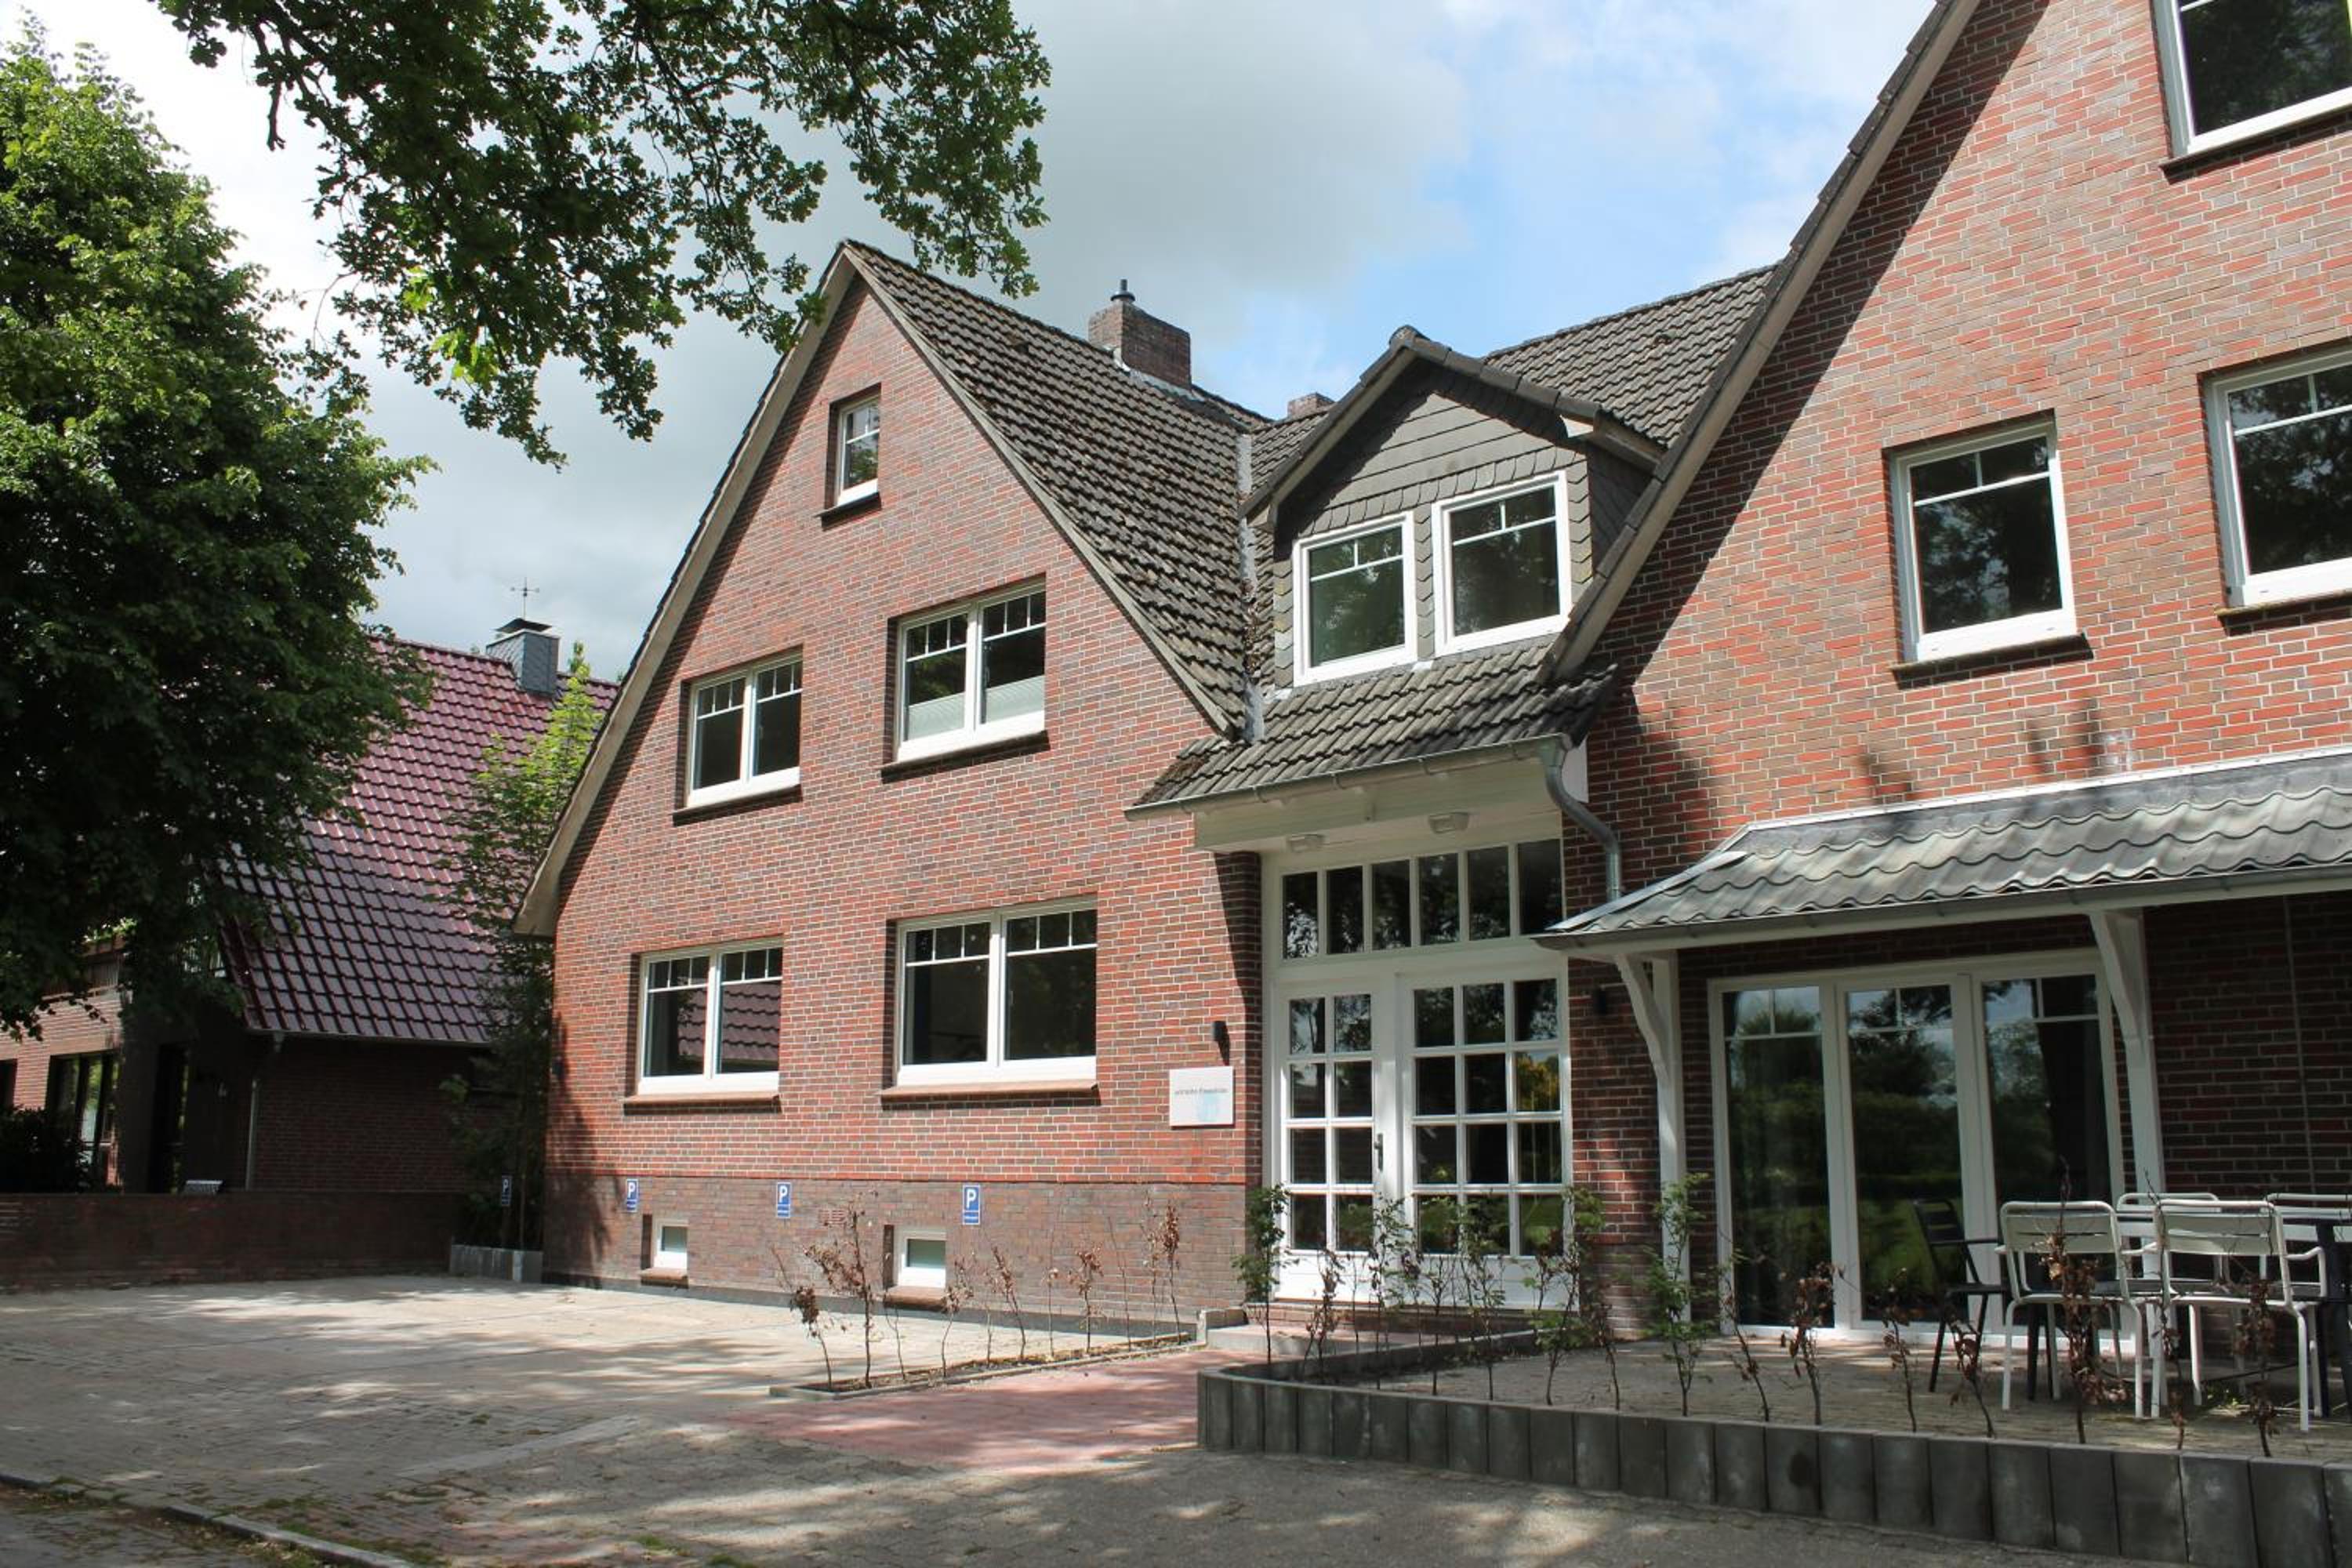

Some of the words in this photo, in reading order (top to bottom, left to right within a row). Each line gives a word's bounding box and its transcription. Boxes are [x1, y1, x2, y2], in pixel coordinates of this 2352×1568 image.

[627, 1181, 636, 1198] P
[779, 1185, 788, 1203] P
[965, 1189, 976, 1209] P
